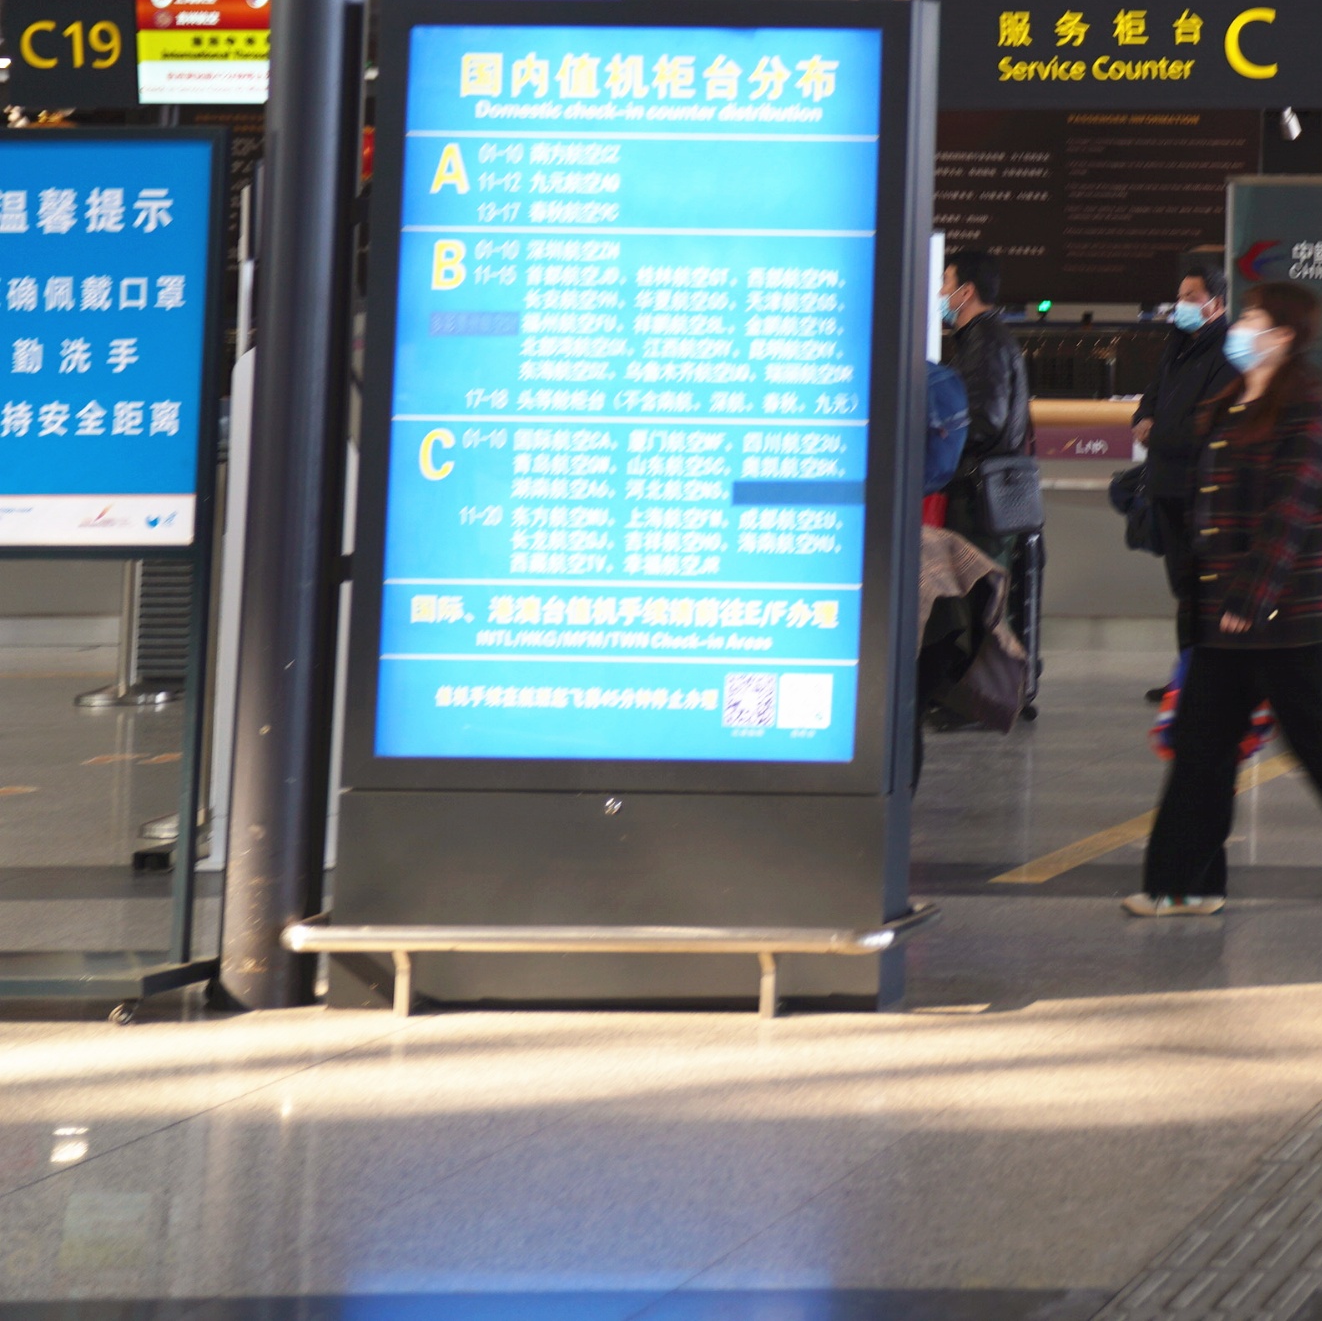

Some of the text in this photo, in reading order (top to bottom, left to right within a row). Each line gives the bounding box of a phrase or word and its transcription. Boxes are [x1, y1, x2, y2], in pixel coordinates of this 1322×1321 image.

[19, 21, 122, 69] C19
[998, 7, 1279, 79] 服务柜台 C
[460, 53, 839, 102] 国内值机柜台分布
[998, 56, 1195, 82] Service Counter
[475, 99, 561, 121] Domestic
[646, 104, 717, 121] counter
[718, 104, 823, 123] distribution
[430, 143, 470, 194] A
[0, 187, 173, 233] 温馨提示
[431, 239, 466, 290] B
[6, 275, 186, 312] 确佩戴口罩
[11, 337, 139, 374] 勤洗手
[0, 399, 182, 437] 持安全距离
[419, 428, 455, 480] C
